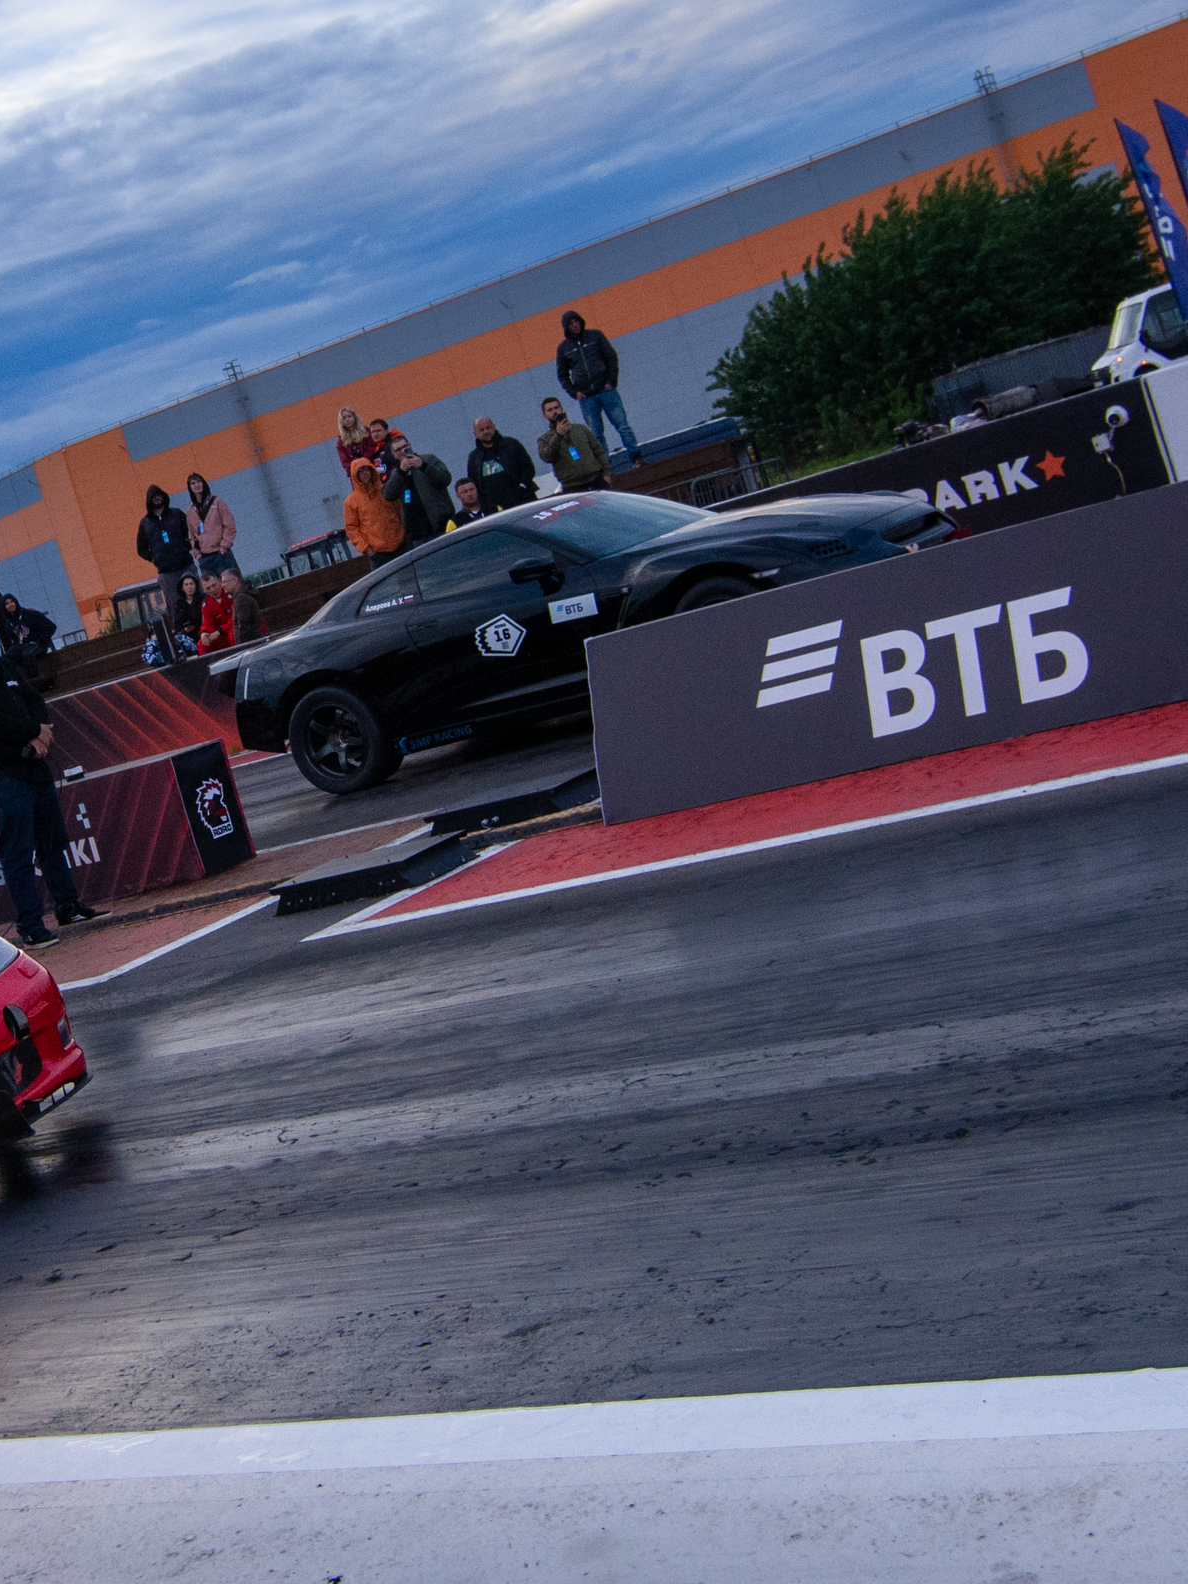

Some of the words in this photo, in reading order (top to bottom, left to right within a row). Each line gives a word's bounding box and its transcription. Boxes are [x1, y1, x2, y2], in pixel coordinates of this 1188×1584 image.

[565, 603, 583, 615] ВТБ
[494, 628, 511, 642] 16
[860, 586, 1090, 739] ВТБ
[434, 725, 472, 742] RACING
